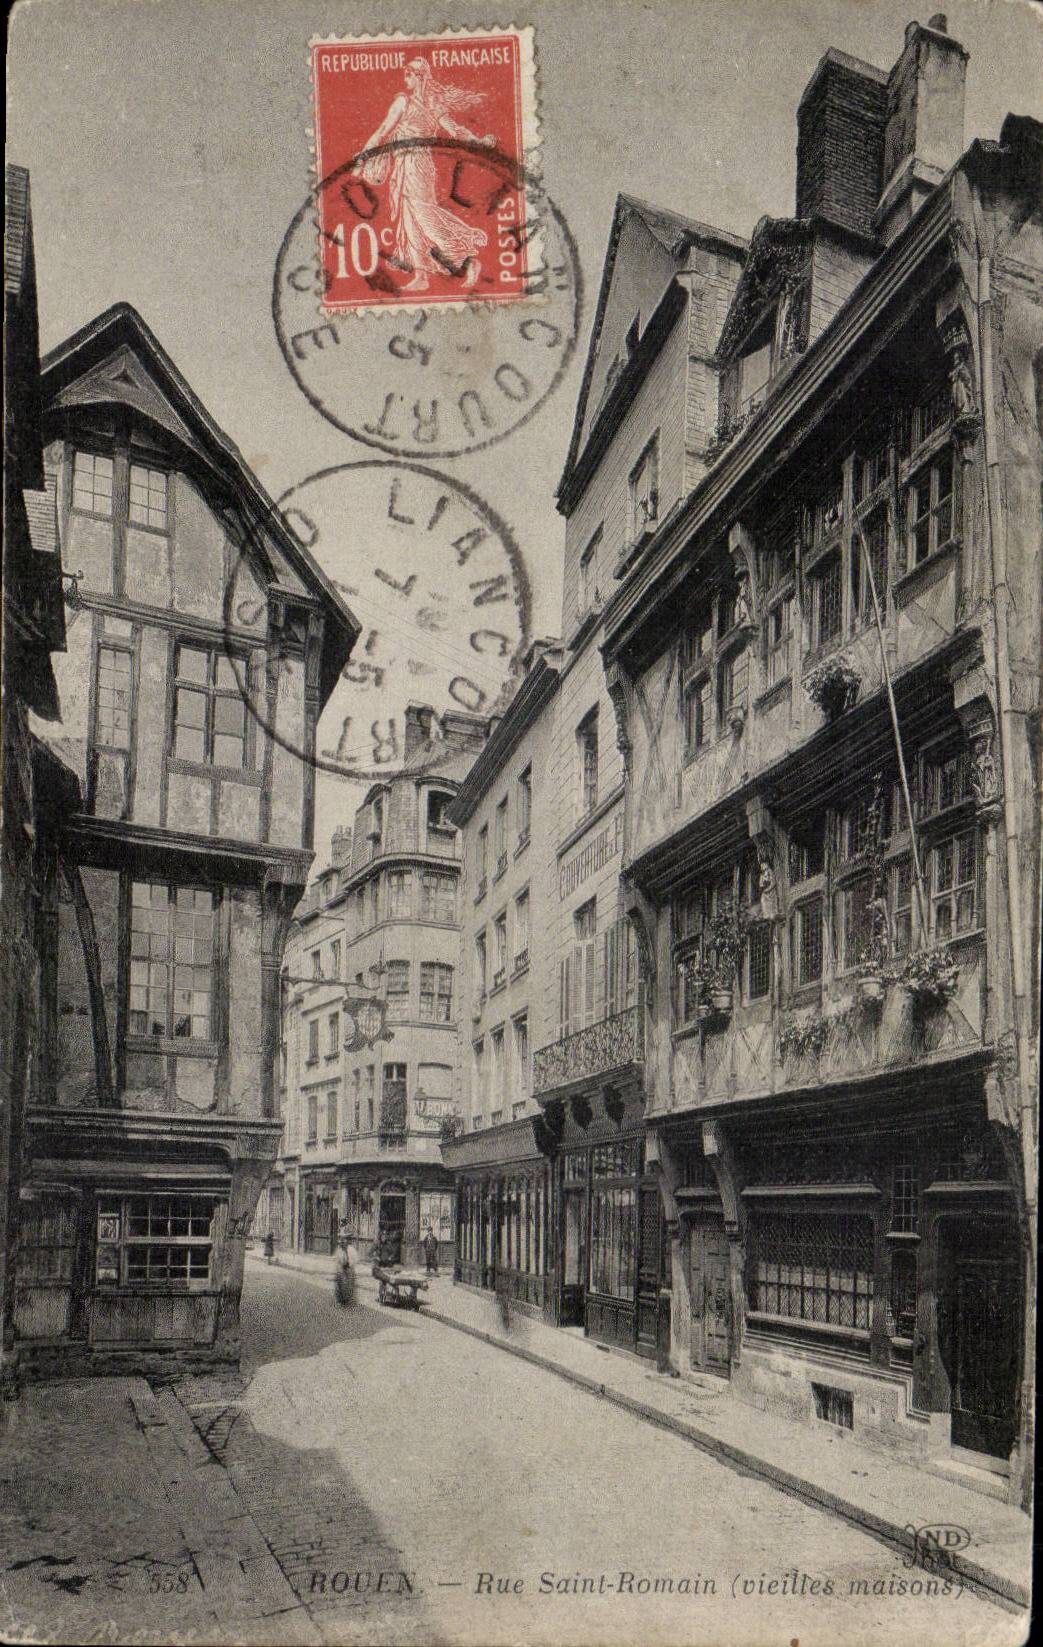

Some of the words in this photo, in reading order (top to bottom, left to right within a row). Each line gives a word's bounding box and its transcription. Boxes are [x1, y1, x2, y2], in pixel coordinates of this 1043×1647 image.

[321, 52, 406, 73] REPUBLIQUE
[432, 46, 511, 69] FRANÇAISE
[497, 197, 517, 283] POSTES
